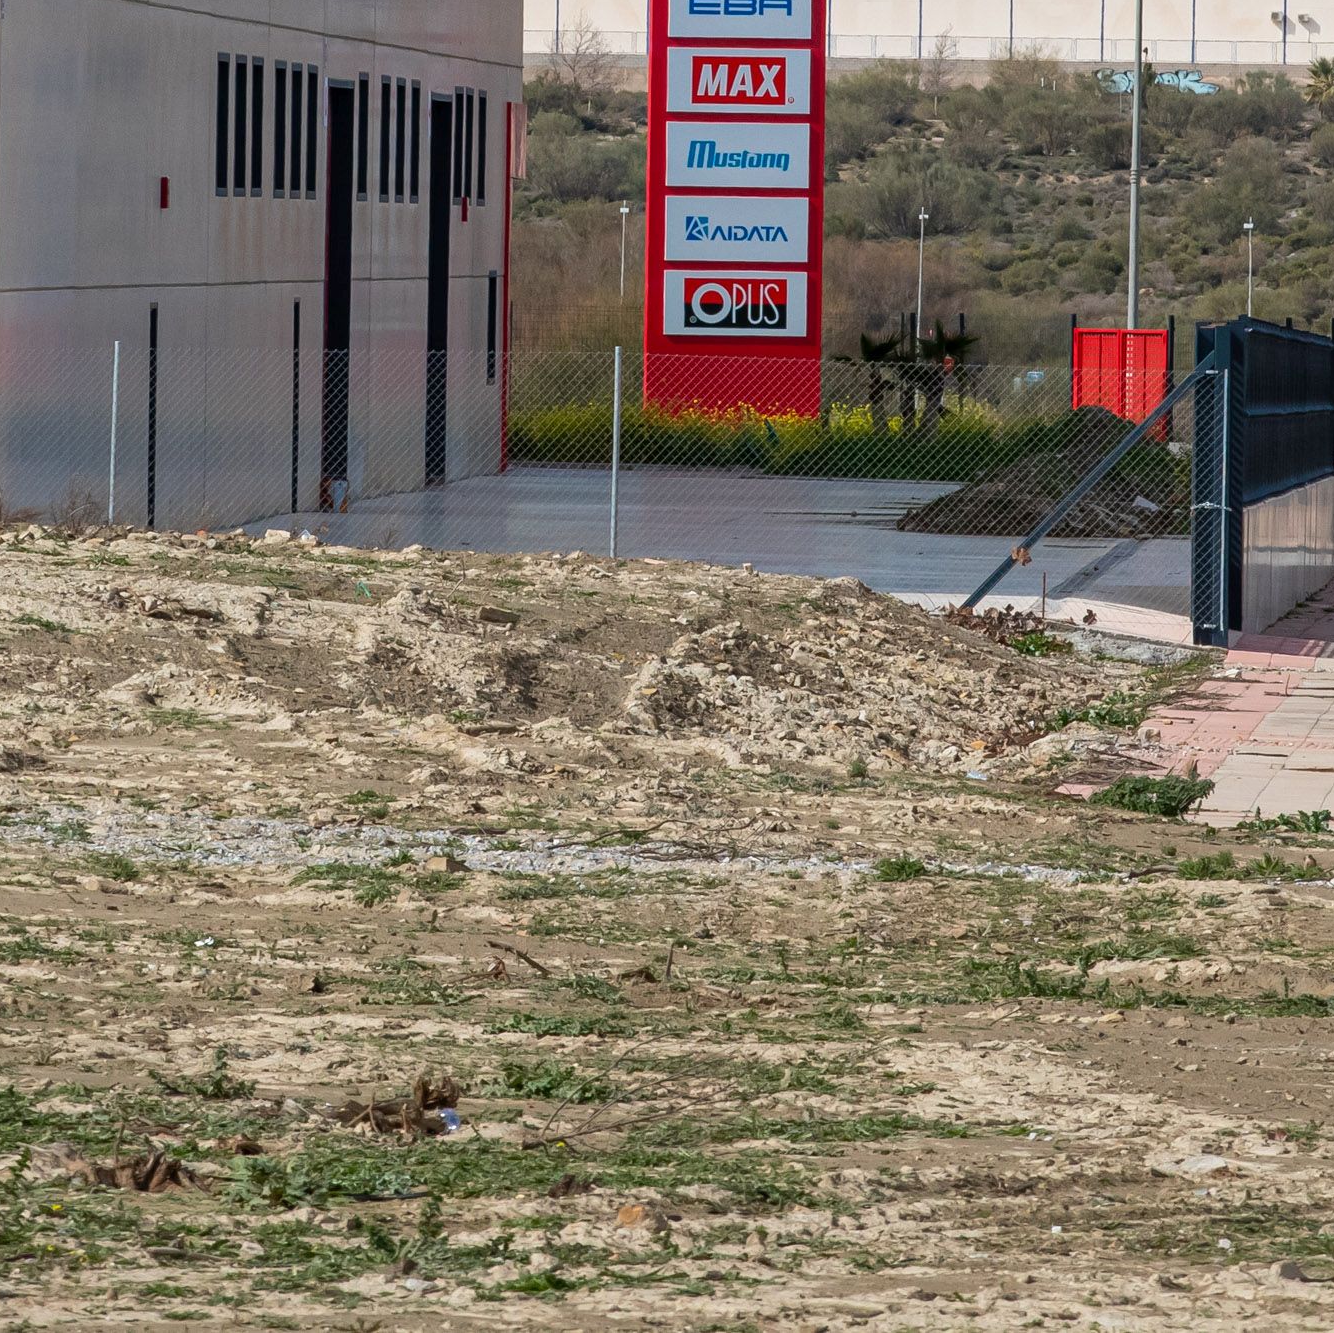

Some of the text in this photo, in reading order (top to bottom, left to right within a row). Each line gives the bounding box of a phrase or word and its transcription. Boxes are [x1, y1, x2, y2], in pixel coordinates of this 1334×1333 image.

[696, 63, 782, 98] MAX
[687, 140, 790, 172] Mustang
[710, 225, 789, 243] AIDATA
[691, 282, 780, 325] OPUS
